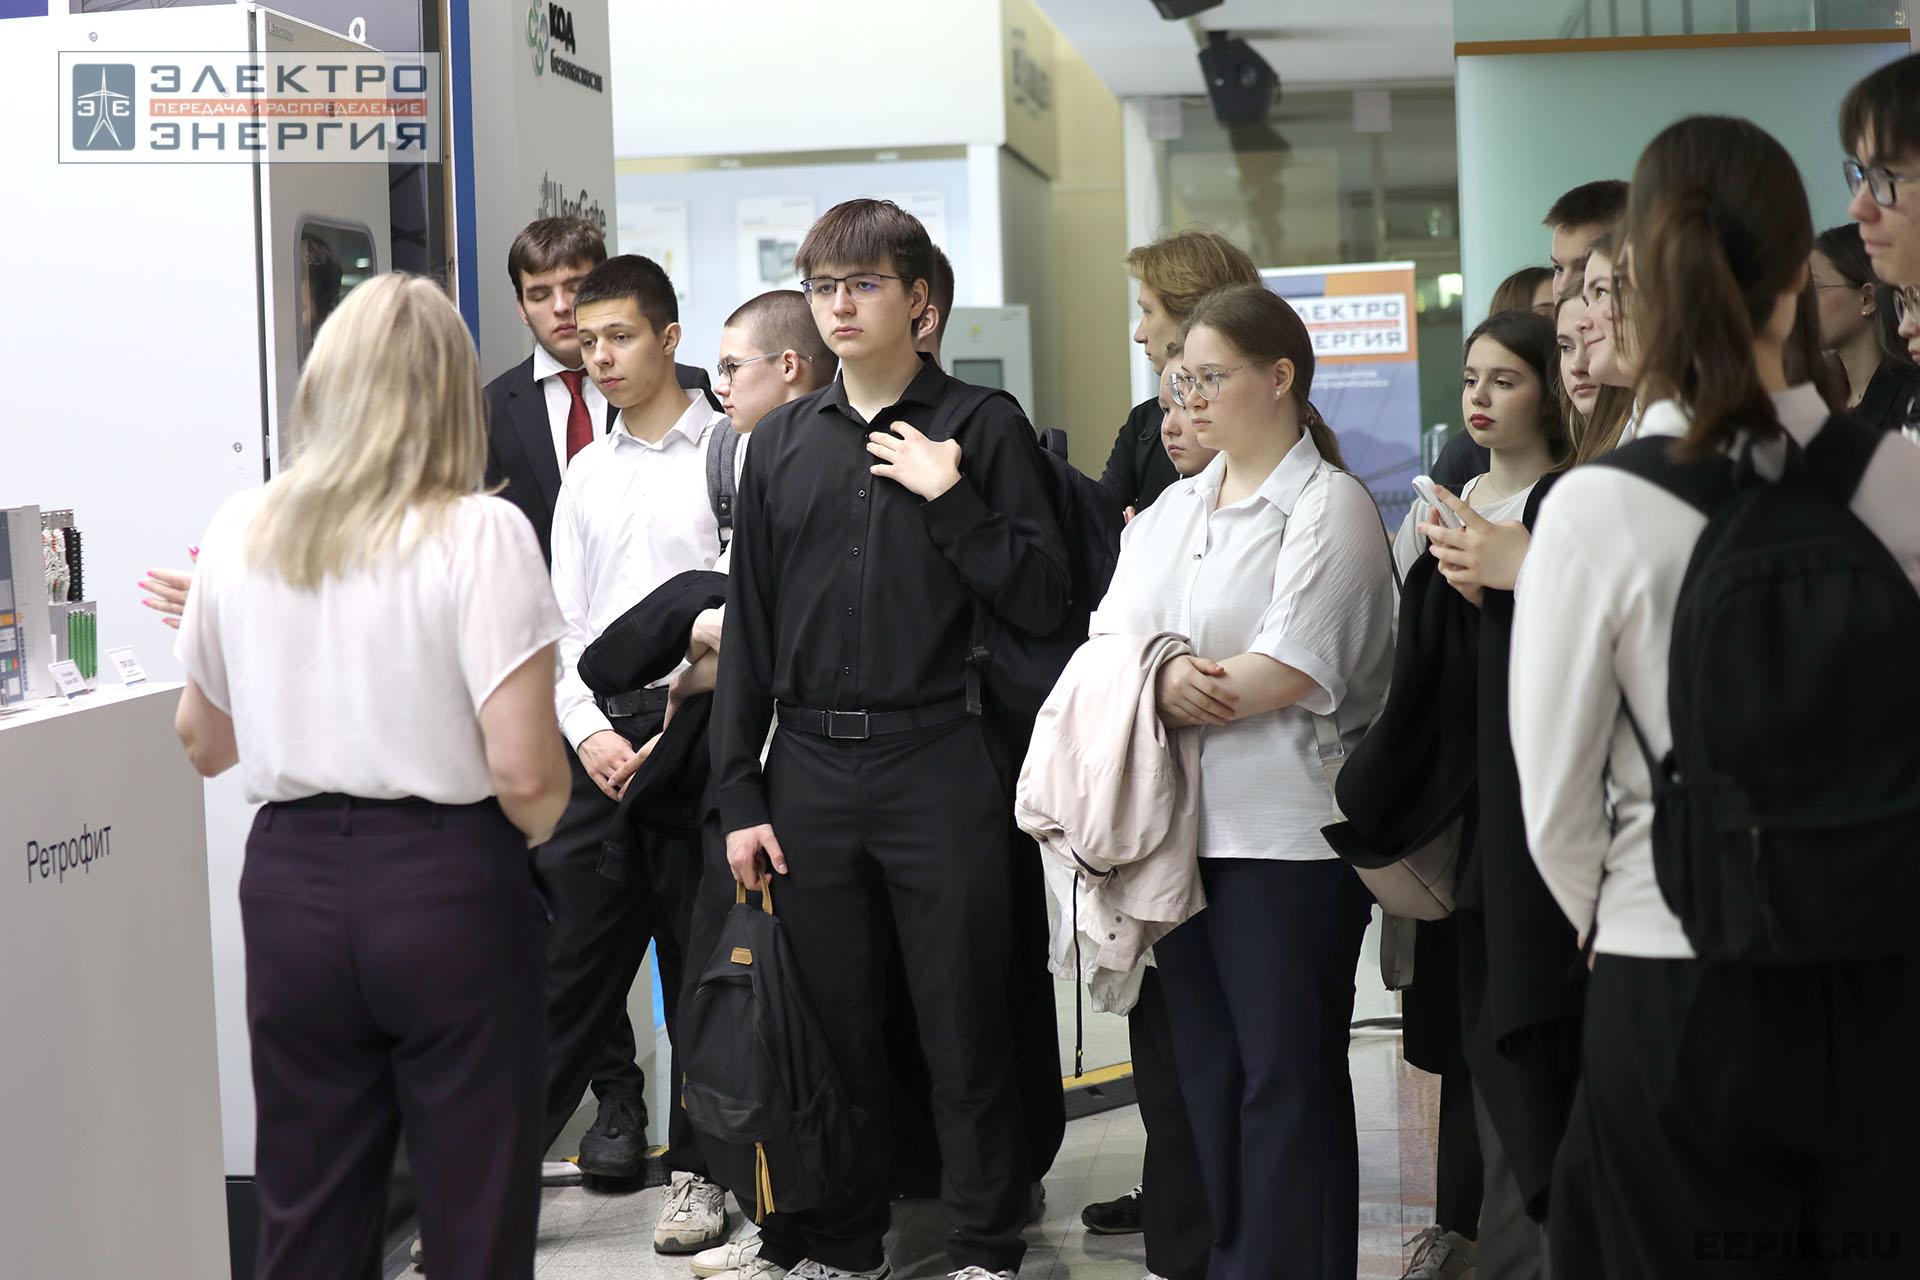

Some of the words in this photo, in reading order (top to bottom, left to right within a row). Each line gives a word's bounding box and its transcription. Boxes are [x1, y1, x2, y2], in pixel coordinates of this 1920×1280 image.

[1298, 302, 1400, 321] ЛЕКТРО
[1315, 332, 1402, 350] ЕРГИЯ
[27, 823, 112, 884] Ретрофит
